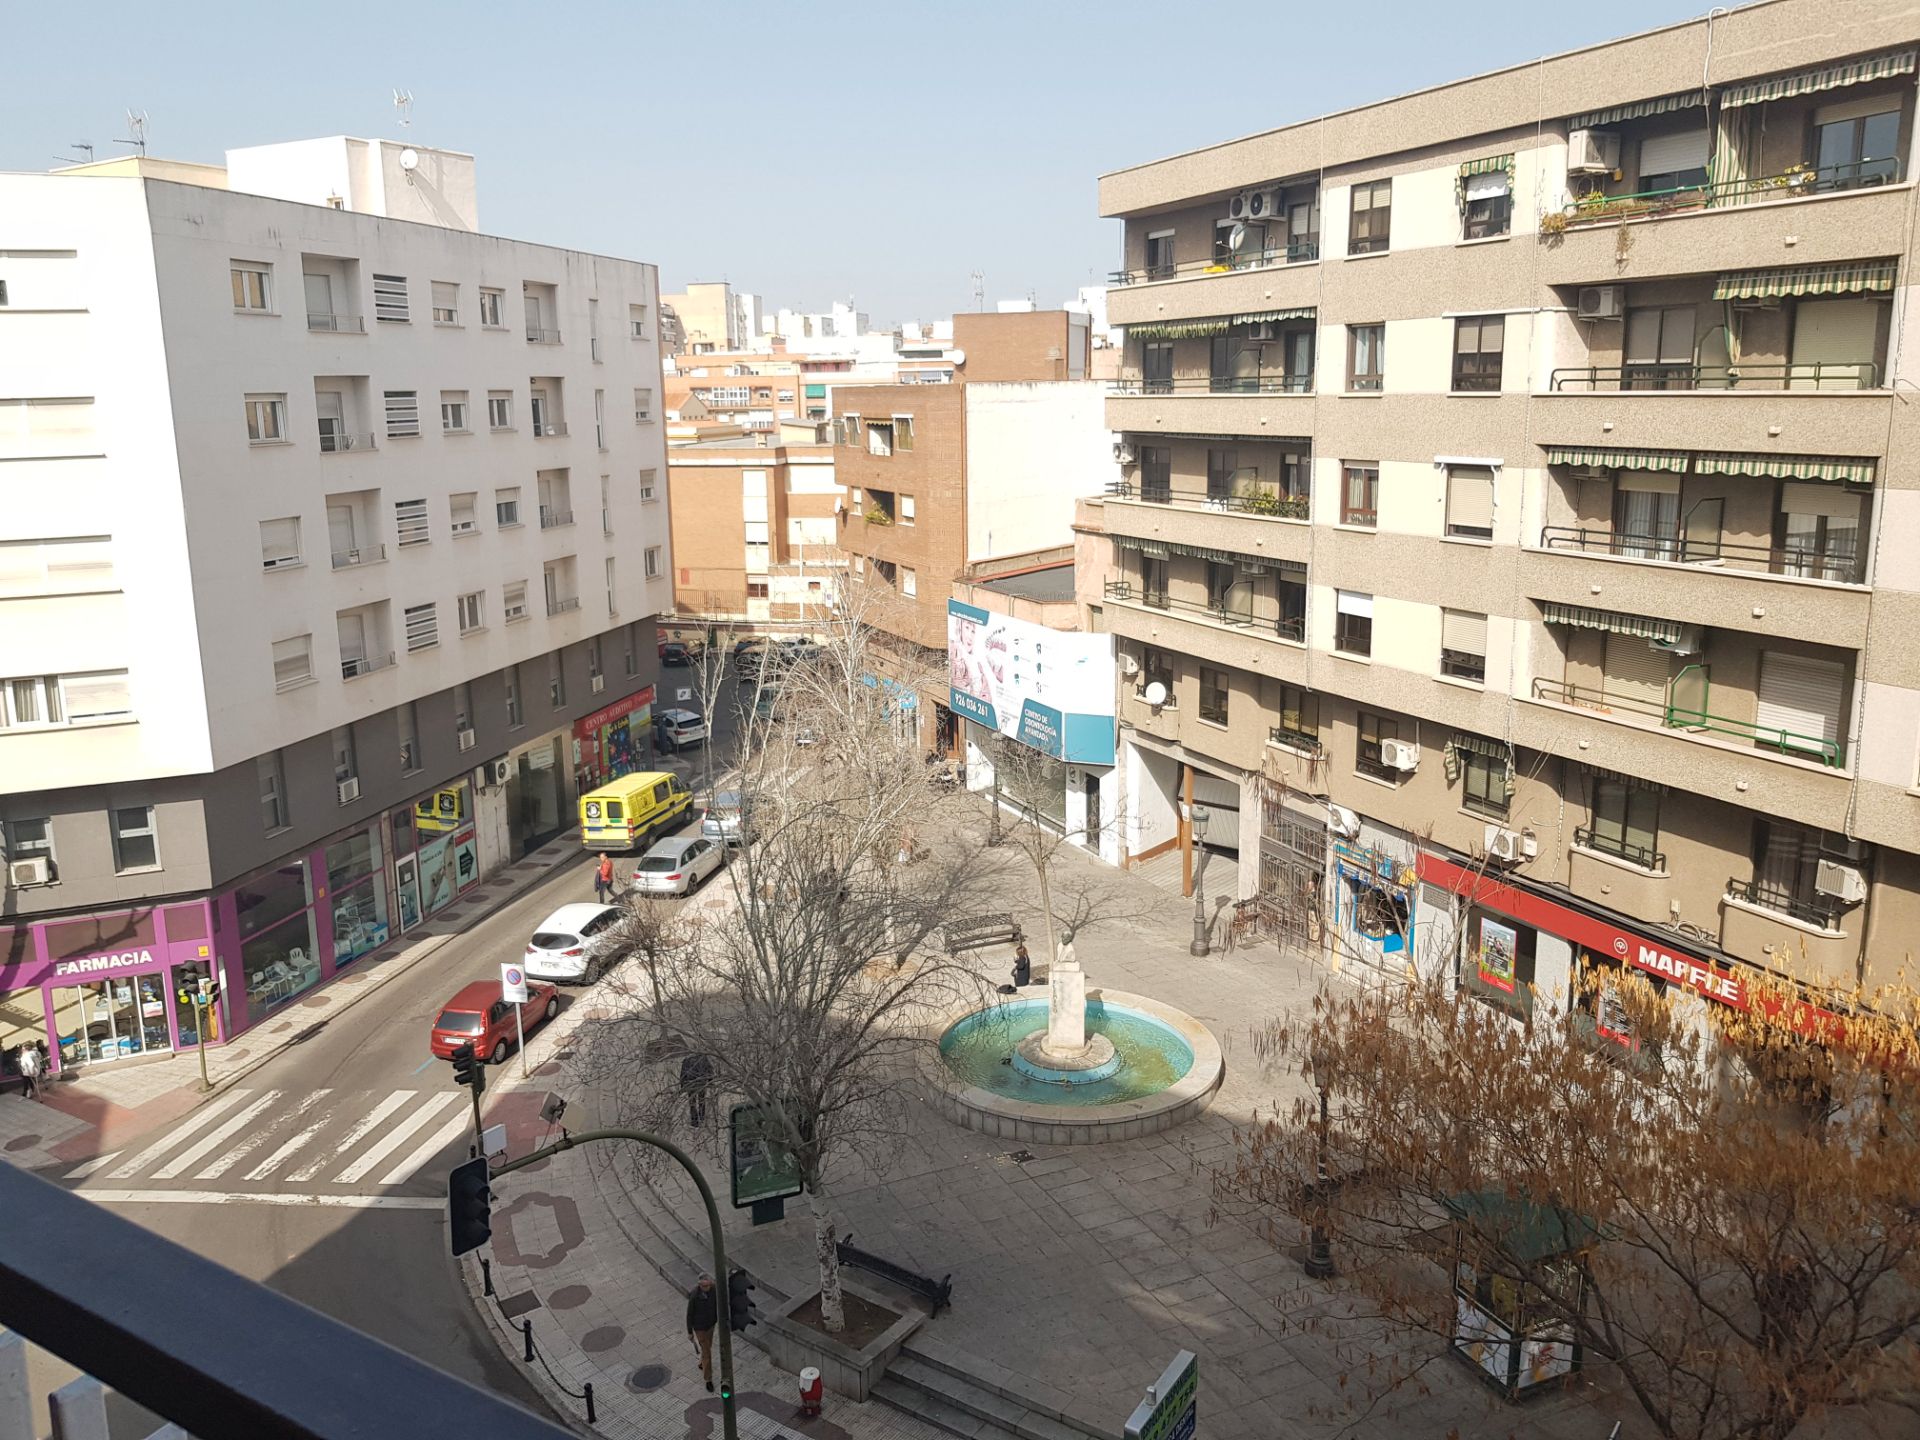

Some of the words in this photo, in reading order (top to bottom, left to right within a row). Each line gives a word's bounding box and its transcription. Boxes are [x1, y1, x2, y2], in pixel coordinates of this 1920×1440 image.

[955, 693, 965, 707] 926
[1042, 715, 1048, 724] DE
[55, 950, 152, 976] FARMACIA
[1639, 945, 1738, 1001] MAPFRE
